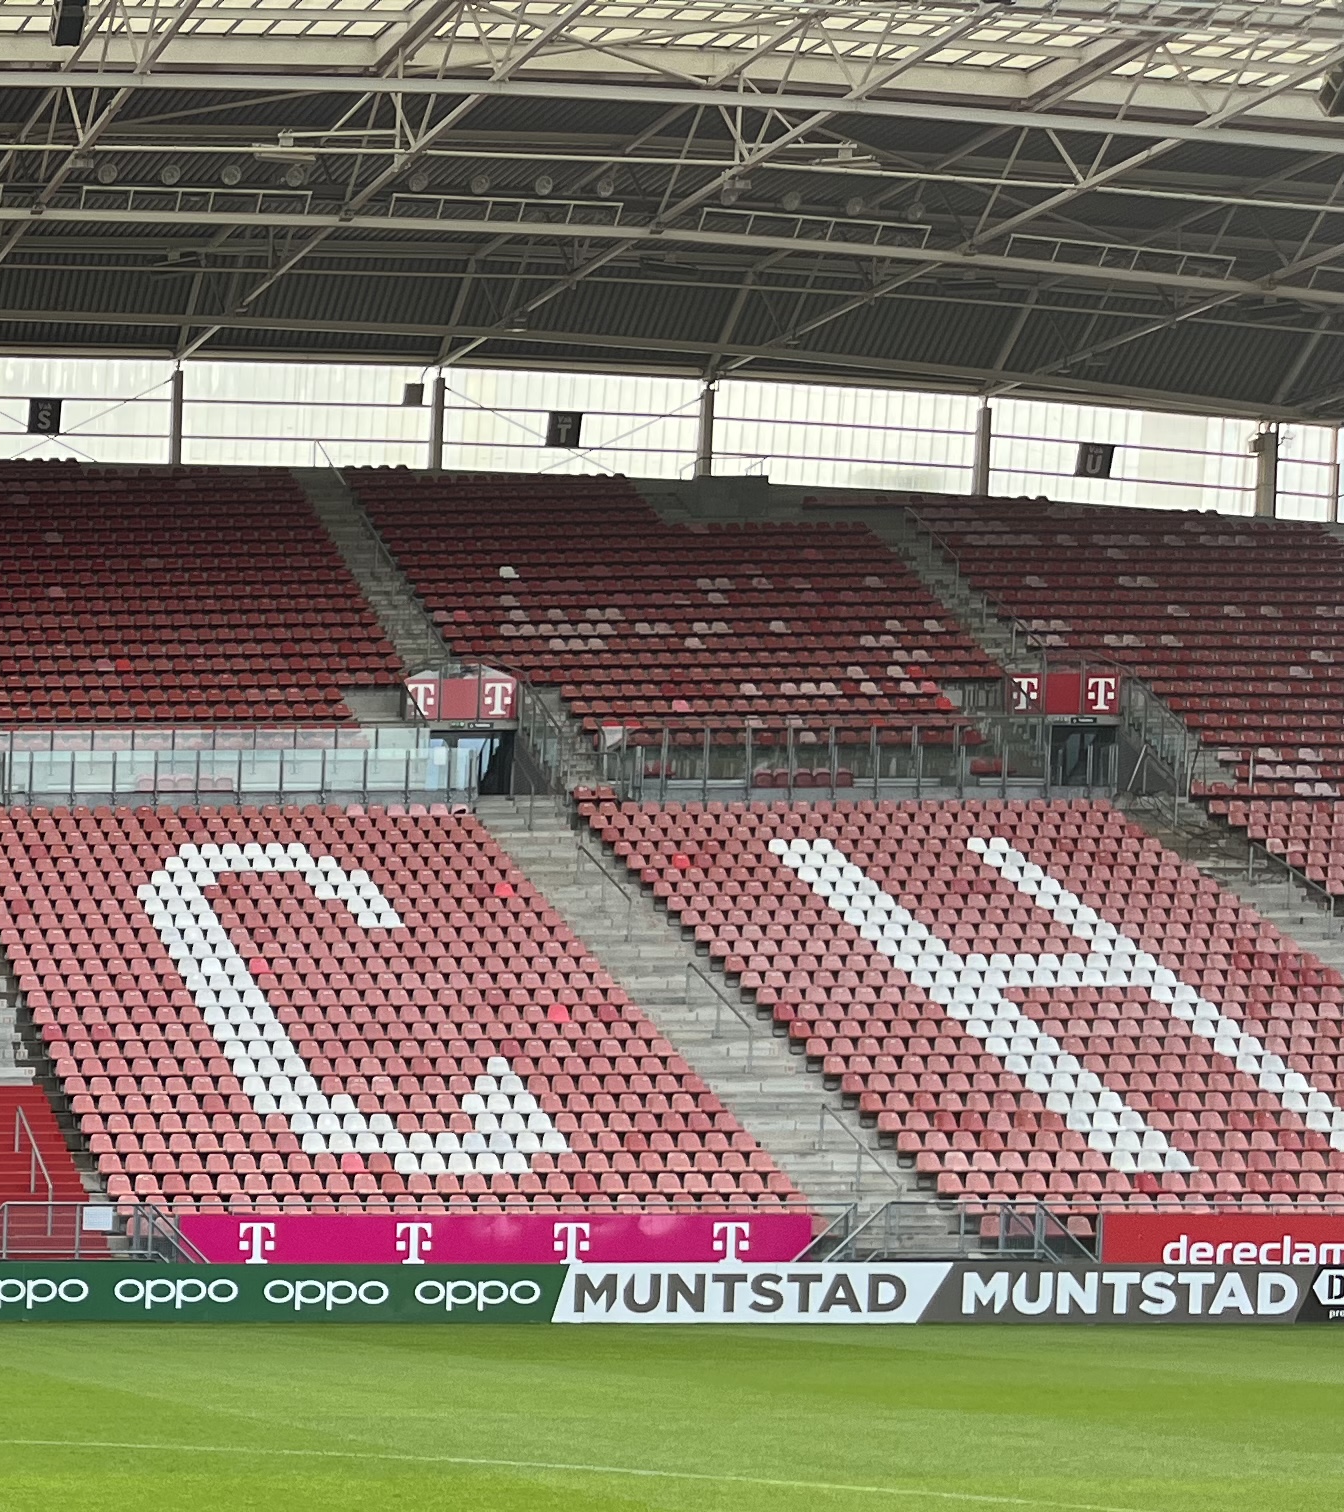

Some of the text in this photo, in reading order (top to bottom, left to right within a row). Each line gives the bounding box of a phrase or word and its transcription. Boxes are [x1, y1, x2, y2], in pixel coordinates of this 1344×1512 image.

[37, 410, 51, 430] S
[557, 424, 572, 443] T
[1086, 454, 1103, 474] U
[114, 1278, 239, 1309] oppo
[264, 1279, 389, 1310] oppo
[415, 1280, 540, 1311] oppo
[574, 1273, 906, 1313] MUNTSTAD
[962, 1271, 1299, 1315] MUNTSTAD
